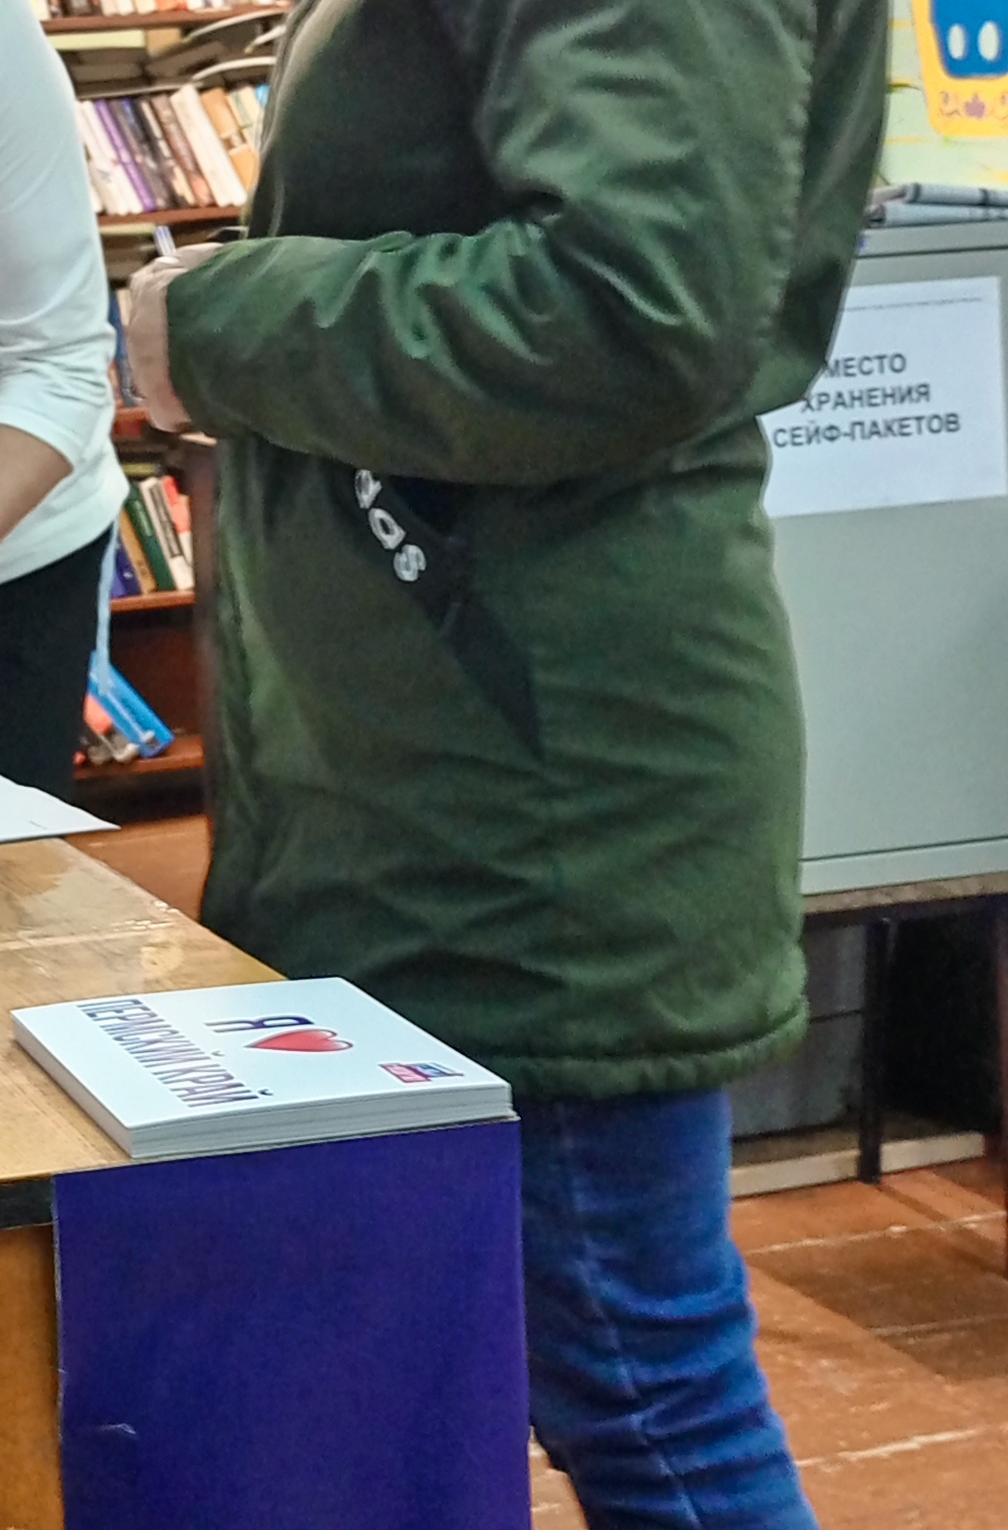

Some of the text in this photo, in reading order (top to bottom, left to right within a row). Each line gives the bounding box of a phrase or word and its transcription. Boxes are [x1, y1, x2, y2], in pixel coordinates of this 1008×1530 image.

[825, 353, 907, 379] МЕСТО
[800, 383, 931, 414] ХРАНЕНИЯ
[772, 412, 961, 448] СЕЙФ-ПАКЕТОВ
[203, 1016, 315, 1033] Я
[76, 998, 274, 1108] ПЕРМСКИЙ КРАЙ
